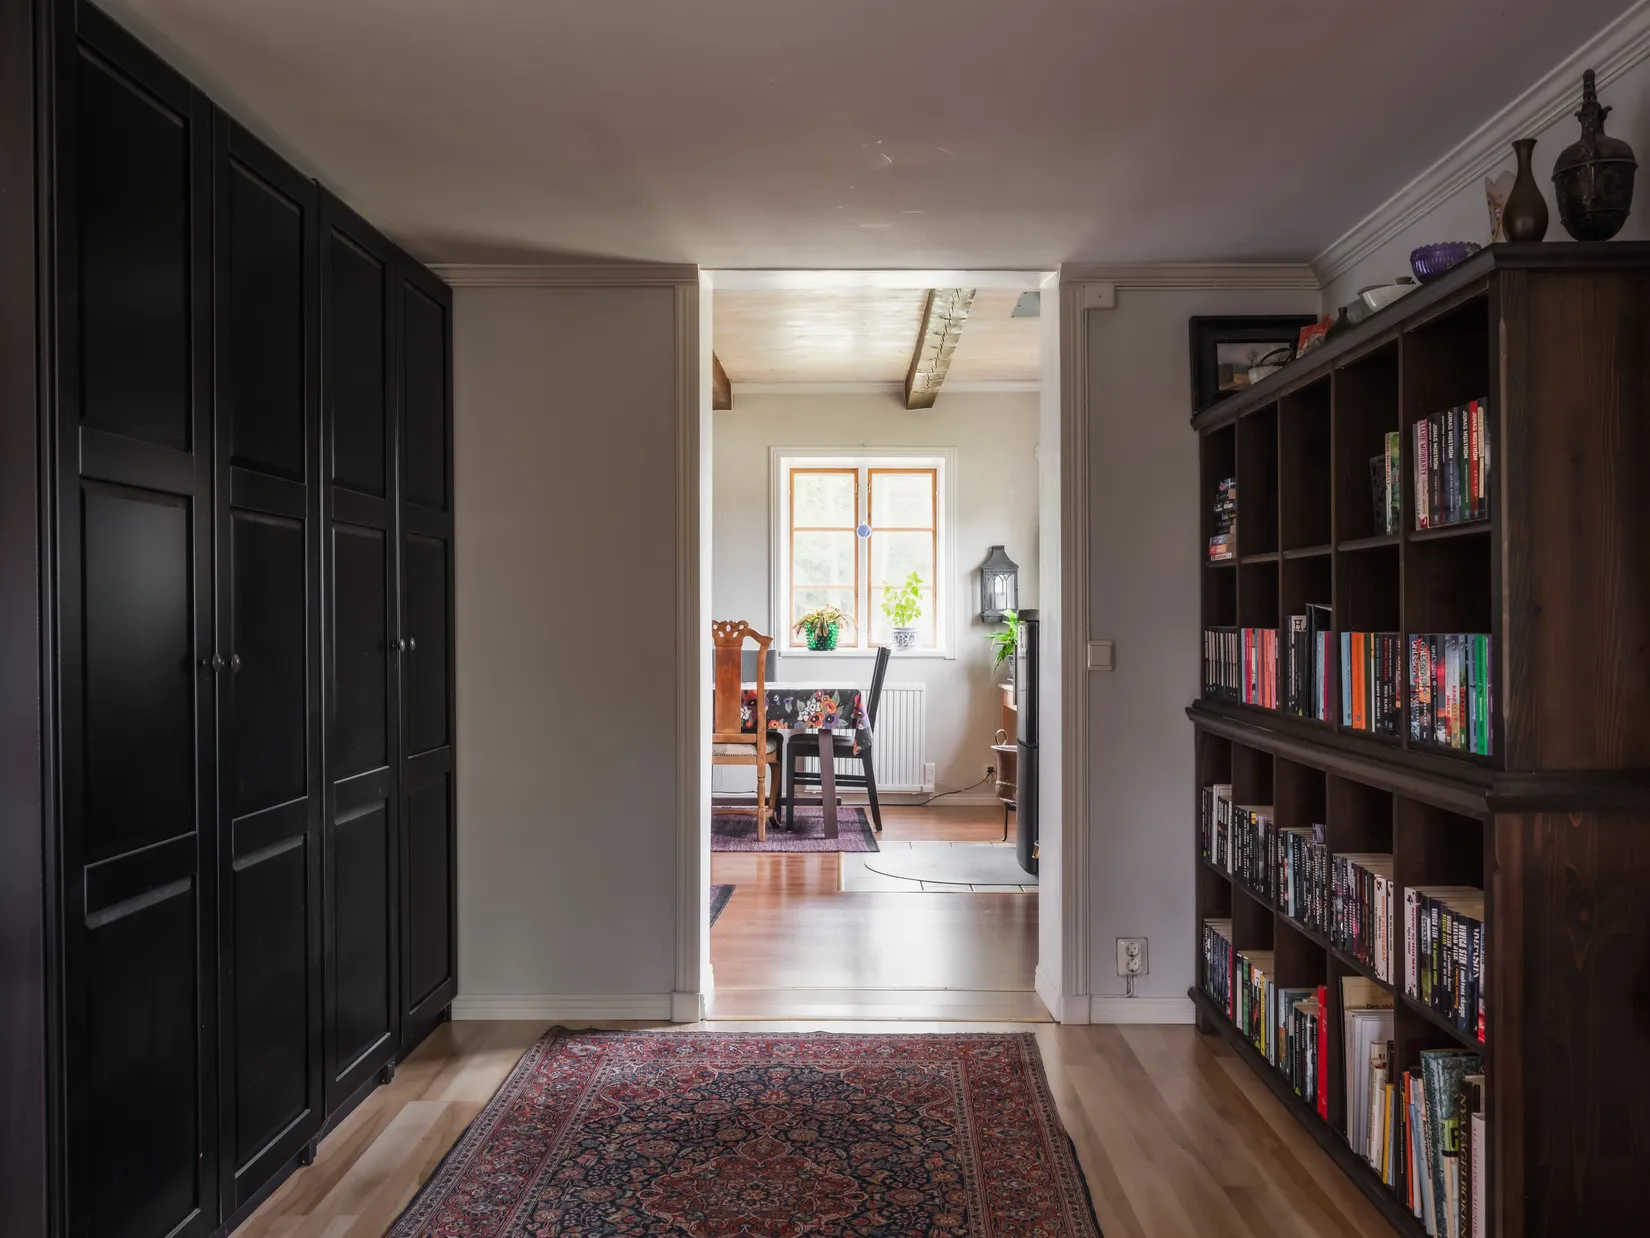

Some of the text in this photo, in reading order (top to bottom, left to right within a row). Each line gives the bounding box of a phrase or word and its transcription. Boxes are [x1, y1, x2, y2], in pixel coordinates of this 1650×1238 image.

[1458, 924, 1468, 965] VIVECA STEN
[1459, 996, 1468, 1018] skugga
[1459, 1093, 1468, 1238] NYA FÅGELBOKEN
